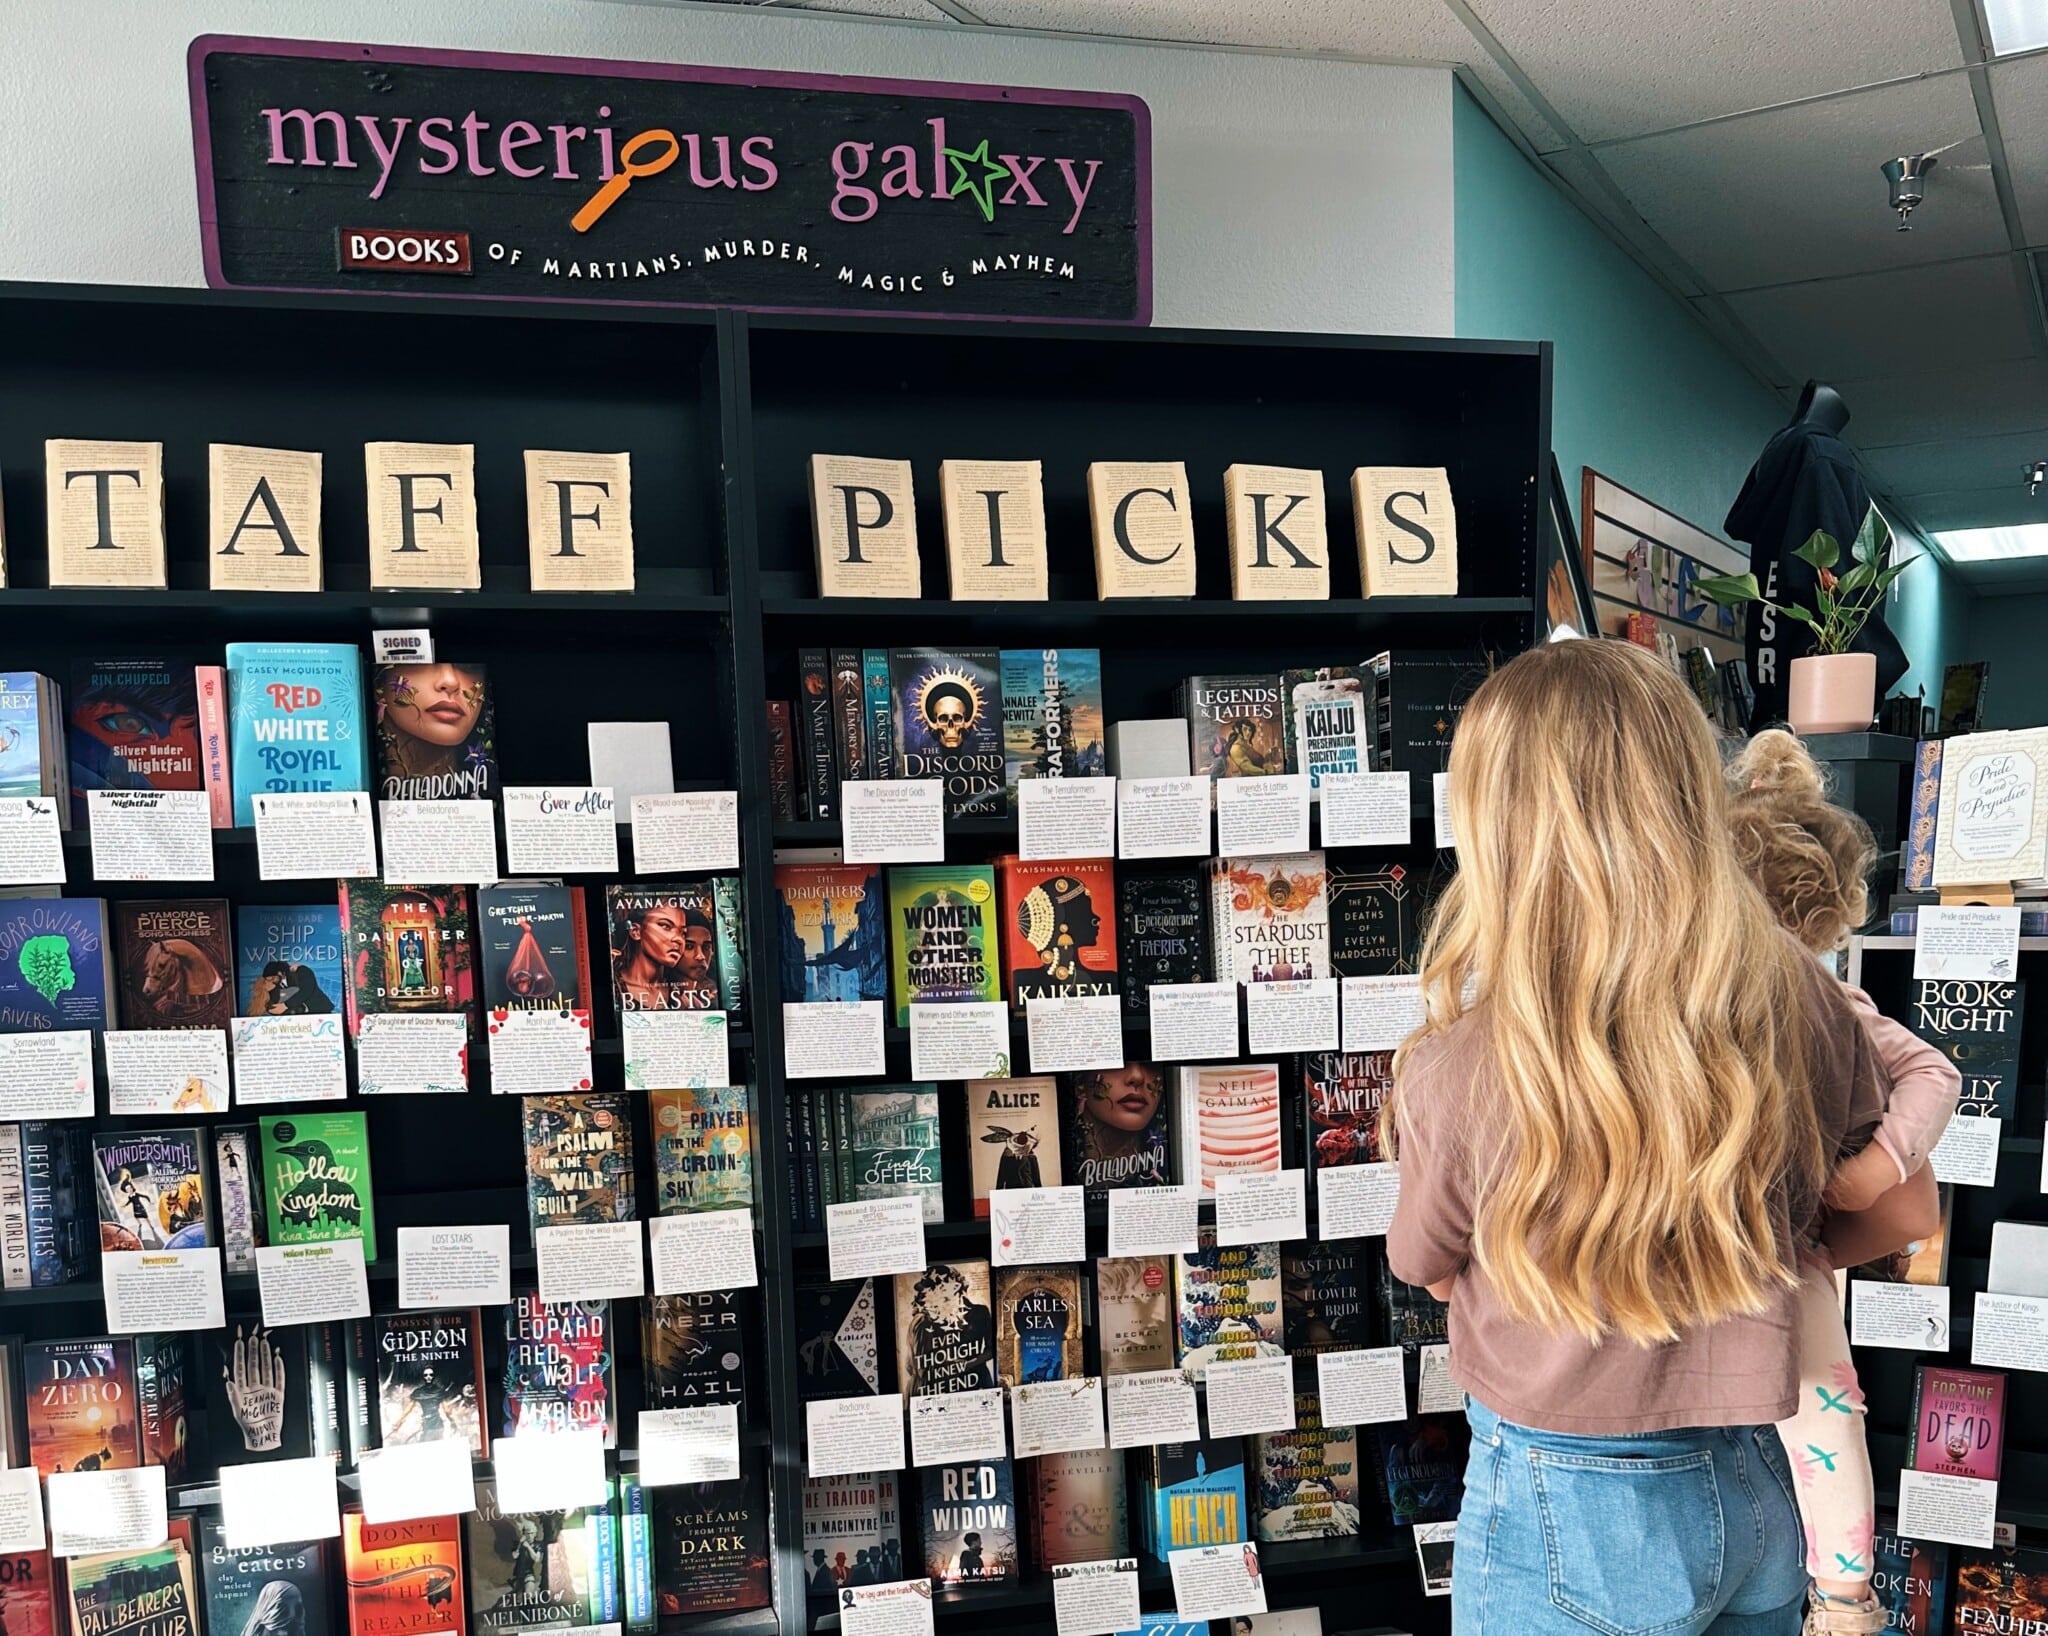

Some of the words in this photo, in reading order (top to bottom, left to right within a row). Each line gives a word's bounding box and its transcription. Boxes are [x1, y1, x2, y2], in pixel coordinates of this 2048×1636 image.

[350, 235, 460, 265] BOOKS
[489, 243, 522, 265] OF
[838, 266, 922, 293] MAGIC
[971, 256, 1076, 281] MAYHEM
[832, 485, 1436, 568] PICKS
[383, 637, 421, 648] SIGNED
[247, 666, 281, 674] CASEY
[283, 667, 342, 676] McQUISTON
[1195, 688, 1278, 705] LEGENDS
[1305, 707, 1356, 738] KAIJU
[254, 719, 329, 742] WHITE
[334, 722, 352, 741] &
[113, 745, 146, 756] Silver
[150, 745, 183, 756] Under
[1308, 736, 1356, 750] PRESERVATION
[258, 746, 341, 774] ROYAL
[1309, 750, 1338, 763] SOCIETY
[1338, 749, 1357, 761] JOHN
[128, 758, 192, 775] Nightfall
[903, 752, 1004, 779] DISCORD
[863, 788, 874, 797] The
[876, 788, 899, 798] Discord
[901, 788, 908, 797] of
[909, 788, 926, 798] Gods
[1042, 786, 1054, 794] The
[1056, 785, 1095, 795] Terraformers
[112, 799, 158, 808] Nightfall
[416, 804, 459, 815] Belladonna
[953, 802, 997, 814] LYONS
[1016, 866, 1071, 874] VAISHNAVI
[1074, 865, 1105, 873] PATEL
[816, 876, 834, 884] THE
[787, 886, 866, 900] DAUGHTERS
[391, 903, 428, 914] THE
[488, 904, 537, 917] GRETCHEN
[616, 898, 664, 909] AYANA
[668, 897, 705, 909] GRAY
[149, 911, 198, 920] TAMORA
[903, 906, 982, 930] WOMEN
[1344, 911, 1384, 921] DEATHS
[1940, 912, 1956, 920] Pride
[1972, 913, 2000, 922] Prejudice
[138, 918, 211, 931] PIERCE
[1359, 924, 1370, 932] OF
[268, 926, 314, 943] SHIP
[360, 929, 466, 941] DAUGHTER
[921, 931, 968, 946] AND
[1234, 922, 1326, 946] STARDUST
[1344, 934, 1386, 946] EVELYN
[246, 945, 338, 962] WRECKED
[908, 948, 983, 965] OTHER
[1248, 946, 1311, 966] THIEF
[1334, 947, 1398, 960] HARDCASTLE
[908, 966, 985, 987] MONSTERS
[377, 986, 455, 997] DOCTOR
[1921, 980, 2004, 1006] BOOK
[2000, 988, 2016, 999] OF
[622, 990, 712, 1011] BEASTS
[1, 1007, 51, 1029] RIVERS
[526, 1016, 557, 1025] Manhunt
[918, 1011, 942, 1021] Women
[942, 1011, 952, 1019] and
[954, 1010, 968, 1019] Other
[969, 1009, 994, 1019] Monsters
[1914, 1002, 2013, 1034] NIGHT
[261, 1024, 277, 1036] Ship
[279, 1022, 312, 1033] Wrecked
[13, 1036, 56, 1048] Sorrowland
[1319, 1054, 1386, 1081] EMPIRE
[1219, 1081, 1257, 1091] NEIL
[986, 1089, 1041, 1109] ALICE
[1206, 1096, 1271, 1108] GAIMAN
[690, 1111, 744, 1129] PRAYER
[557, 1131, 614, 1152] PSALM
[100, 1141, 197, 1171] WUNDERSMITH
[540, 1157, 558, 1169] FOR
[560, 1156, 581, 1169] THE
[681, 1152, 742, 1174] CROWN-
[1217, 1158, 1261, 1168] American
[276, 1159, 358, 1190] Hollow
[550, 1171, 609, 1191] WILD-
[864, 1166, 932, 1184] OFFER
[666, 1181, 695, 1198] SHY
[274, 1186, 365, 1215] Kingdom
[537, 1196, 578, 1215] BUILT
[833, 1206, 868, 1217] Dreamland
[870, 1202, 912, 1212] Billionaires
[432, 1234, 448, 1244] LOST
[450, 1233, 472, 1244] STARS
[142, 1256, 179, 1265] Nevermoor
[283, 1249, 303, 1259] Hollow
[304, 1247, 333, 1258] Kingdom
[1219, 1251, 1247, 1264] AND
[1220, 1285, 1249, 1299] AND
[1304, 1287, 1357, 1301] FLOWER
[1882, 1284, 1913, 1292] Ascendant
[1002, 1299, 1076, 1313] STARLESS
[1196, 1301, 1277, 1317] TOMORROW
[1325, 1303, 1361, 1317] BRIDE
[1979, 1299, 1989, 1308] The
[1990, 1299, 2012, 1309] Justice
[2013, 1301, 2021, 1309] of
[2022, 1302, 2039, 1313] Kings
[386, 1319, 432, 1327] TAMSYN
[435, 1317, 462, 1326] MUIR
[506, 1316, 603, 1341] LEOPARD
[656, 1313, 736, 1329] WEIR
[1026, 1314, 1054, 1329] SEA
[932, 1333, 961, 1347] EVEN
[1115, 1330, 1160, 1338] SECRET
[914, 1343, 979, 1368] THOUGH
[1112, 1344, 1163, 1354] HISTORY
[1215, 1345, 1256, 1360] ZEVIN
[542, 1363, 598, 1386] WOLF
[42, 1381, 122, 1407] ZERO
[661, 1379, 742, 1397] HAIL
[1932, 1380, 1994, 1400] FORTUNE
[242, 1392, 276, 1407] SEANAN
[839, 1401, 870, 1411] Radiance
[1935, 1400, 1967, 1413] FAVORS
[1971, 1403, 1988, 1415] THE
[1927, 1412, 1991, 1450] DEAD
[251, 1433, 279, 1448] GAME
[1935, 1463, 1976, 1475] STEPHEN
[942, 1467, 997, 1501] RED
[826, 1489, 876, 1506] TRAITOR
[675, 1511, 749, 1525] SCREAMS
[821, 1518, 878, 1532] MACINTYRE
[932, 1505, 1007, 1531] WIDOW
[1169, 1494, 1238, 1546] HENCH
[366, 1523, 441, 1543] DON'T
[689, 1527, 714, 1536] FROM
[718, 1525, 736, 1534] THE
[680, 1536, 746, 1555] DARK
[1202, 1547, 1219, 1557] Hench
[238, 1555, 306, 1573] eaters
[375, 1554, 433, 1571] FEAR
[214, 1590, 249, 1599] chapman
[82, 1582, 182, 1636] PALLBEARERS
[483, 1603, 583, 1628] MELNIBONÉ
[363, 1611, 454, 1631] REAPER
